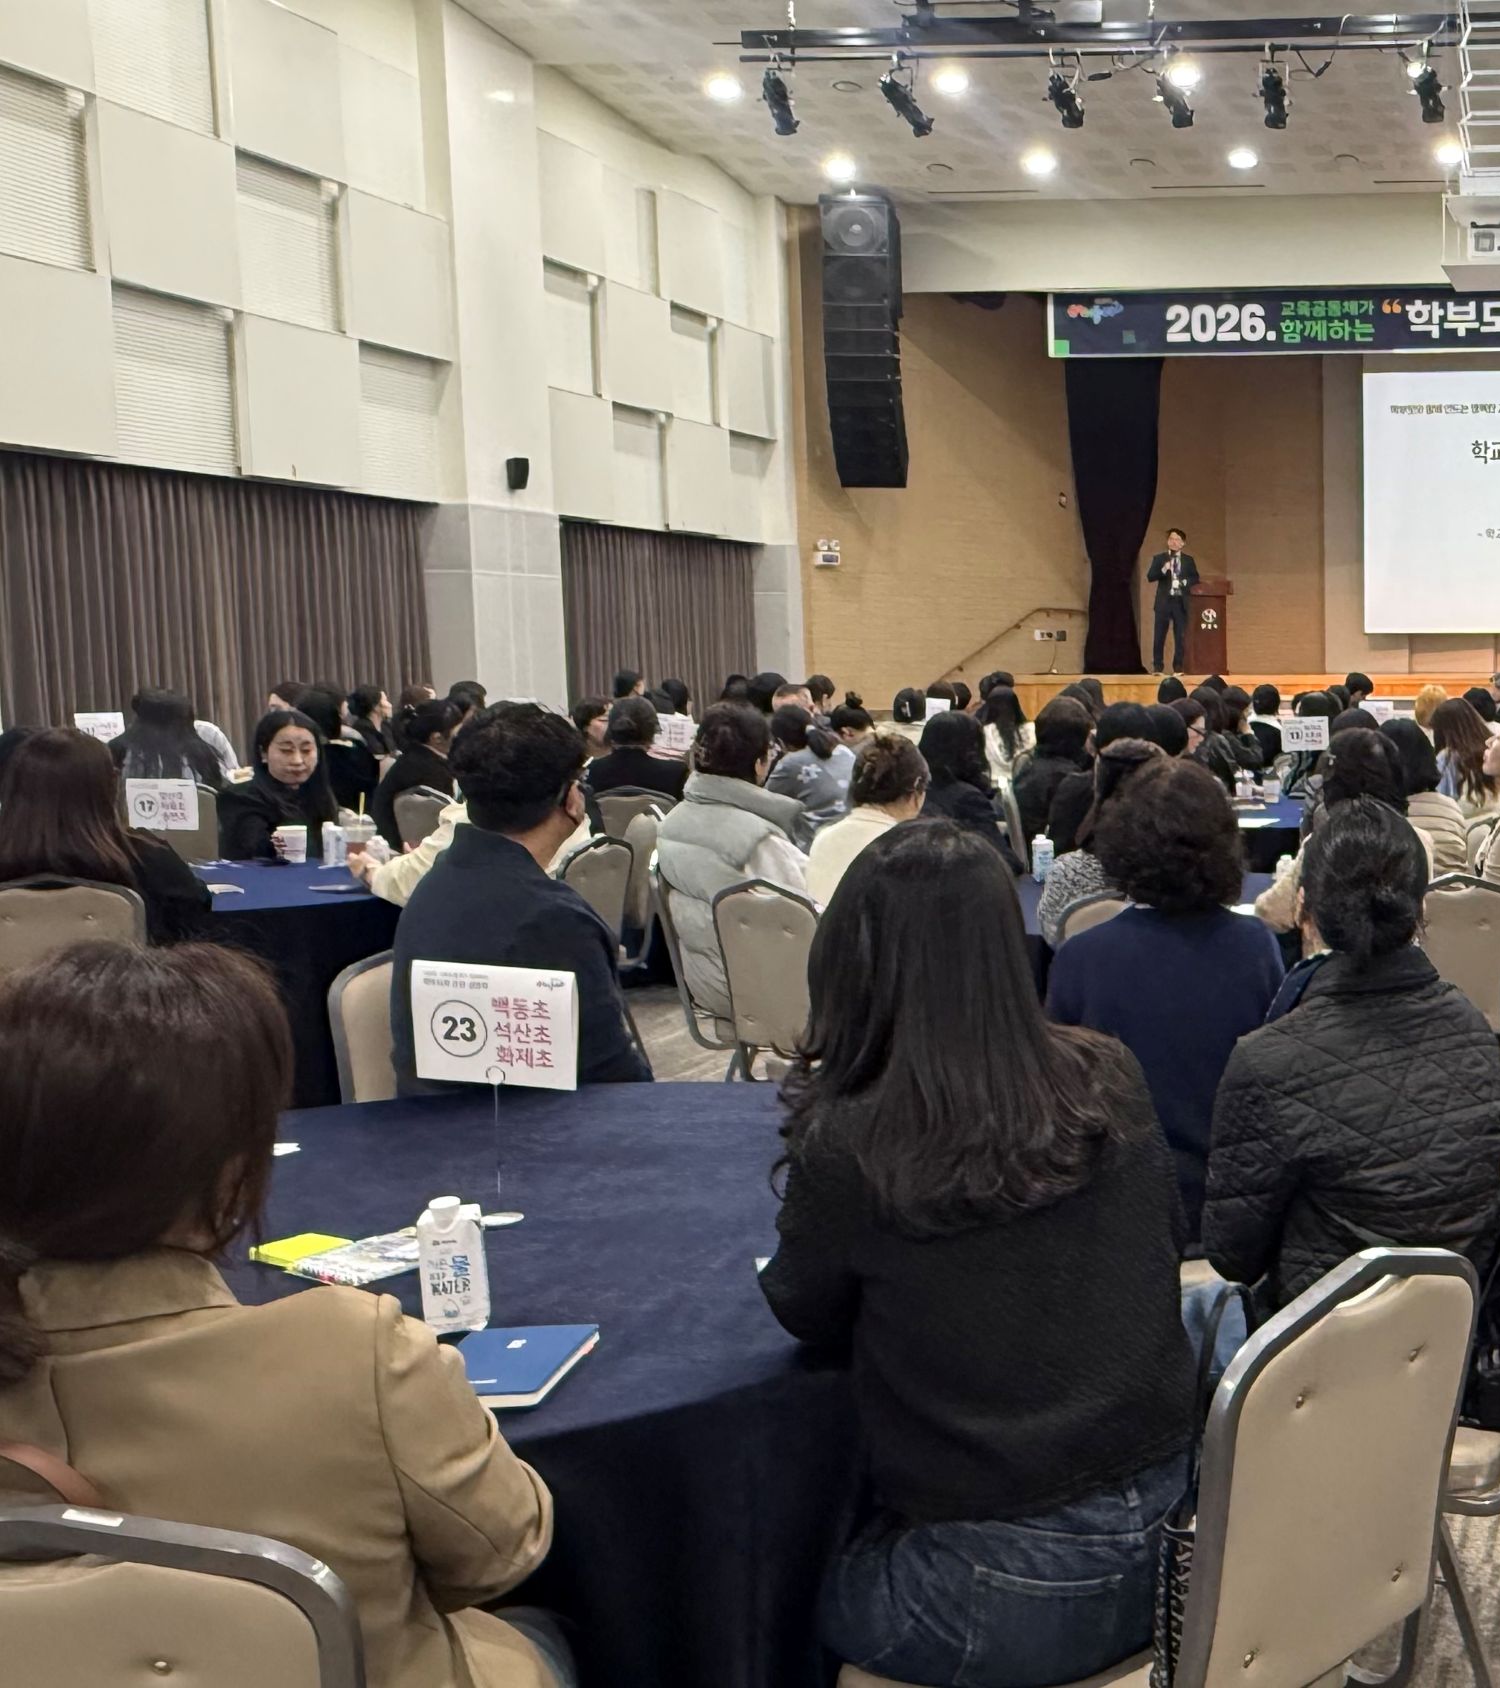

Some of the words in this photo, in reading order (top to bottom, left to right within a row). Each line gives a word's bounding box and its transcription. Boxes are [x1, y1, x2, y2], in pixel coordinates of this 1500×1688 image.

[1280, 300, 1374, 317] 교육공동체가
[1165, 303, 1277, 343] 2026.
[1279, 319, 1375, 343] 함께하는
[139, 800, 155, 812] 17
[442, 1015, 477, 1042] 23
[493, 1021, 552, 1046] 석산초
[495, 1044, 554, 1069] 화제초
